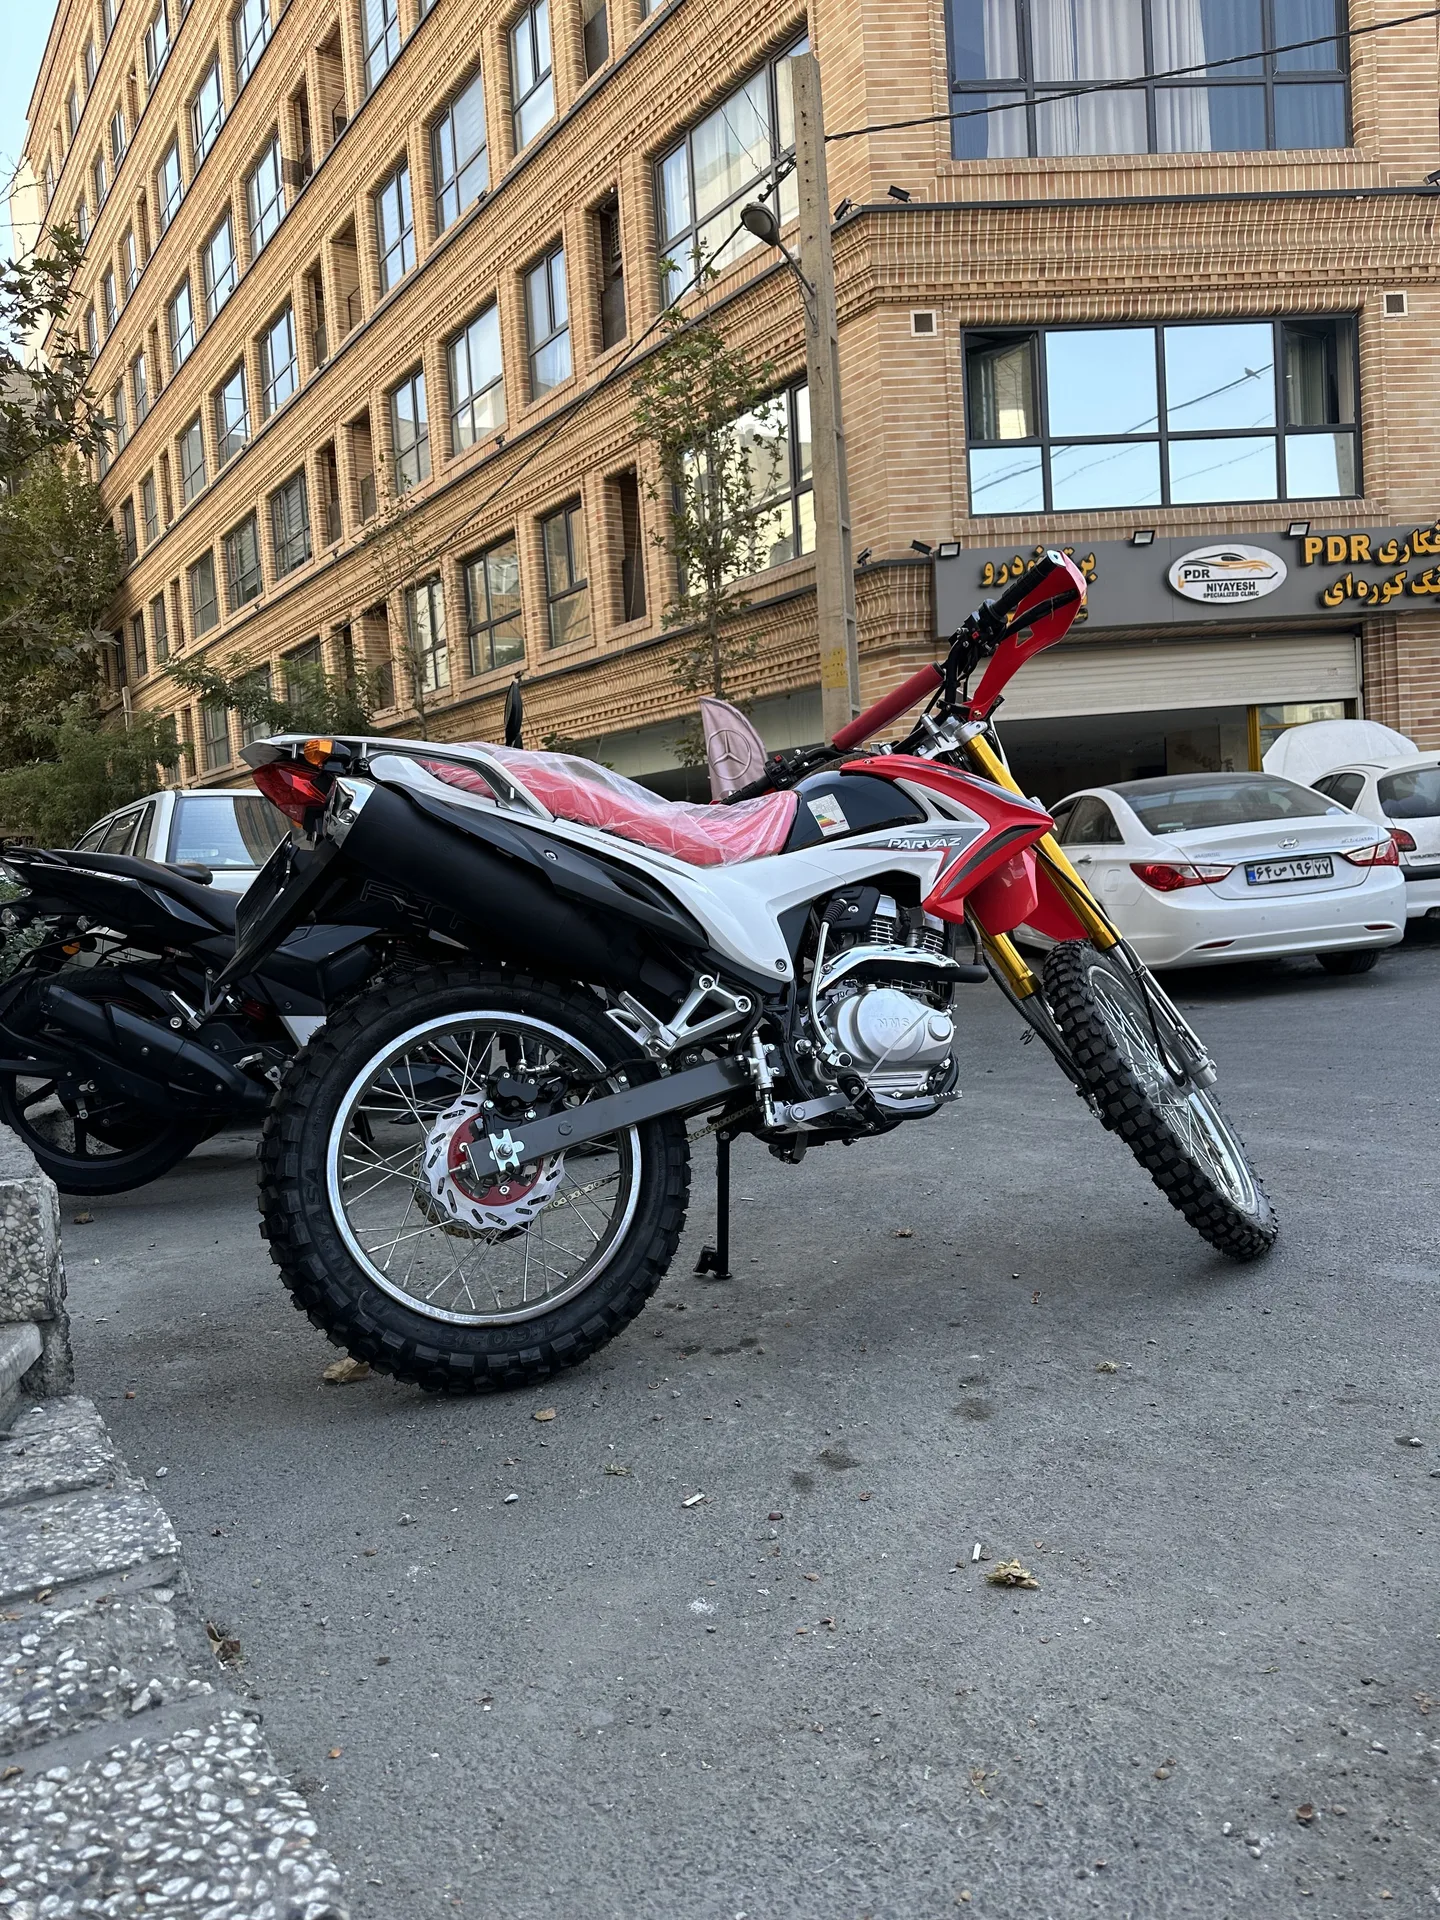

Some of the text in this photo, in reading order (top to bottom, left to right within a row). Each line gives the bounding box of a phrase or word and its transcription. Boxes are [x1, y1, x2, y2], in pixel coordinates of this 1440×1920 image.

[1303, 534, 1372, 564] PDR
[1184, 569, 1210, 579] PDR
[1206, 581, 1256, 592] NIYAYESH
[1203, 591, 1240, 599] SPECIALIZED
[887, 836, 962, 850] PARVAZ
[876, 1017, 911, 1029] NMS
